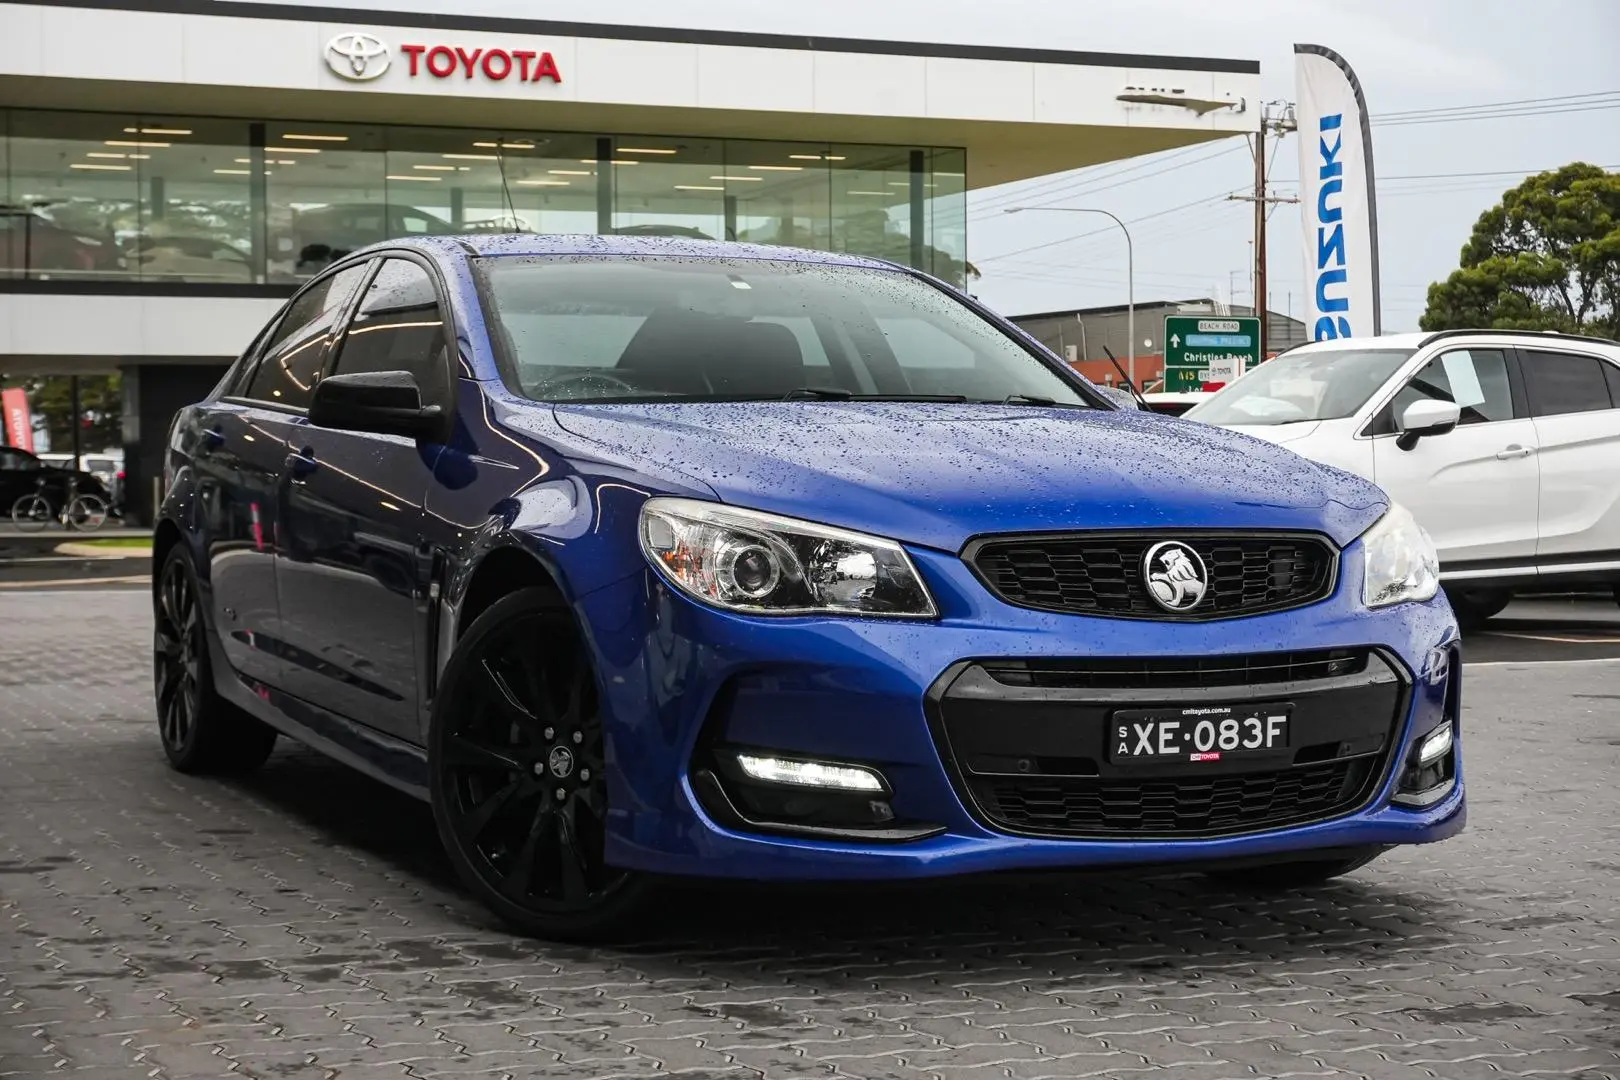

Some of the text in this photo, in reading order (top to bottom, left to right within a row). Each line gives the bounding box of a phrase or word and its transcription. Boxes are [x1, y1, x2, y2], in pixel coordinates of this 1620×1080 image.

[401, 44, 562, 84] TOYOTA
[1199, 322, 1239, 331] BEACH ROAD
[1183, 352, 1225, 362] Christies
[1182, 707, 1232, 716] cmitoyota.com.au
[1201, 752, 1220, 760] TOYOTA
